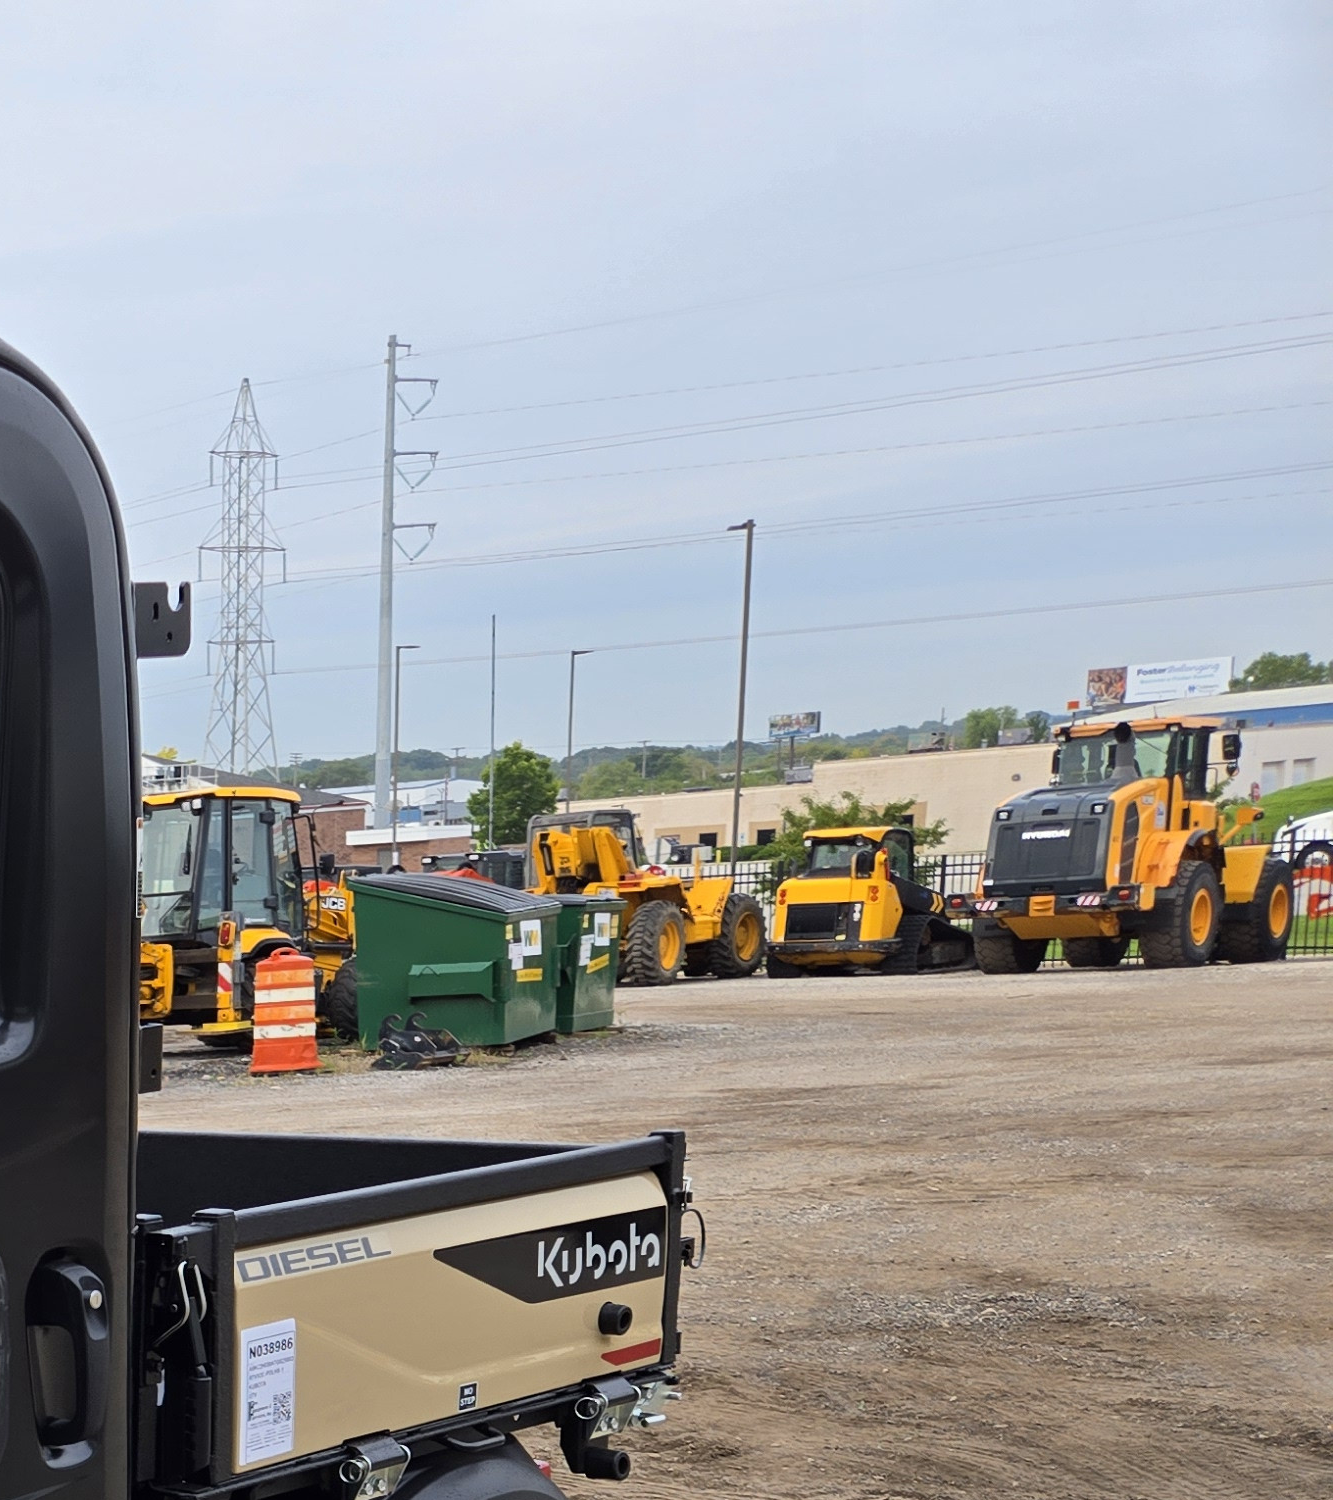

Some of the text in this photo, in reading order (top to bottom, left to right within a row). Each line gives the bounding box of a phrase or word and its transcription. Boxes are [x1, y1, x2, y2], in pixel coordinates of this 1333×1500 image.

[321, 897, 346, 910] JCB
[236, 1237, 392, 1283] DIESEL
[537, 1222, 661, 1288] Kubota
[249, 1337, 294, 1359] N038986
